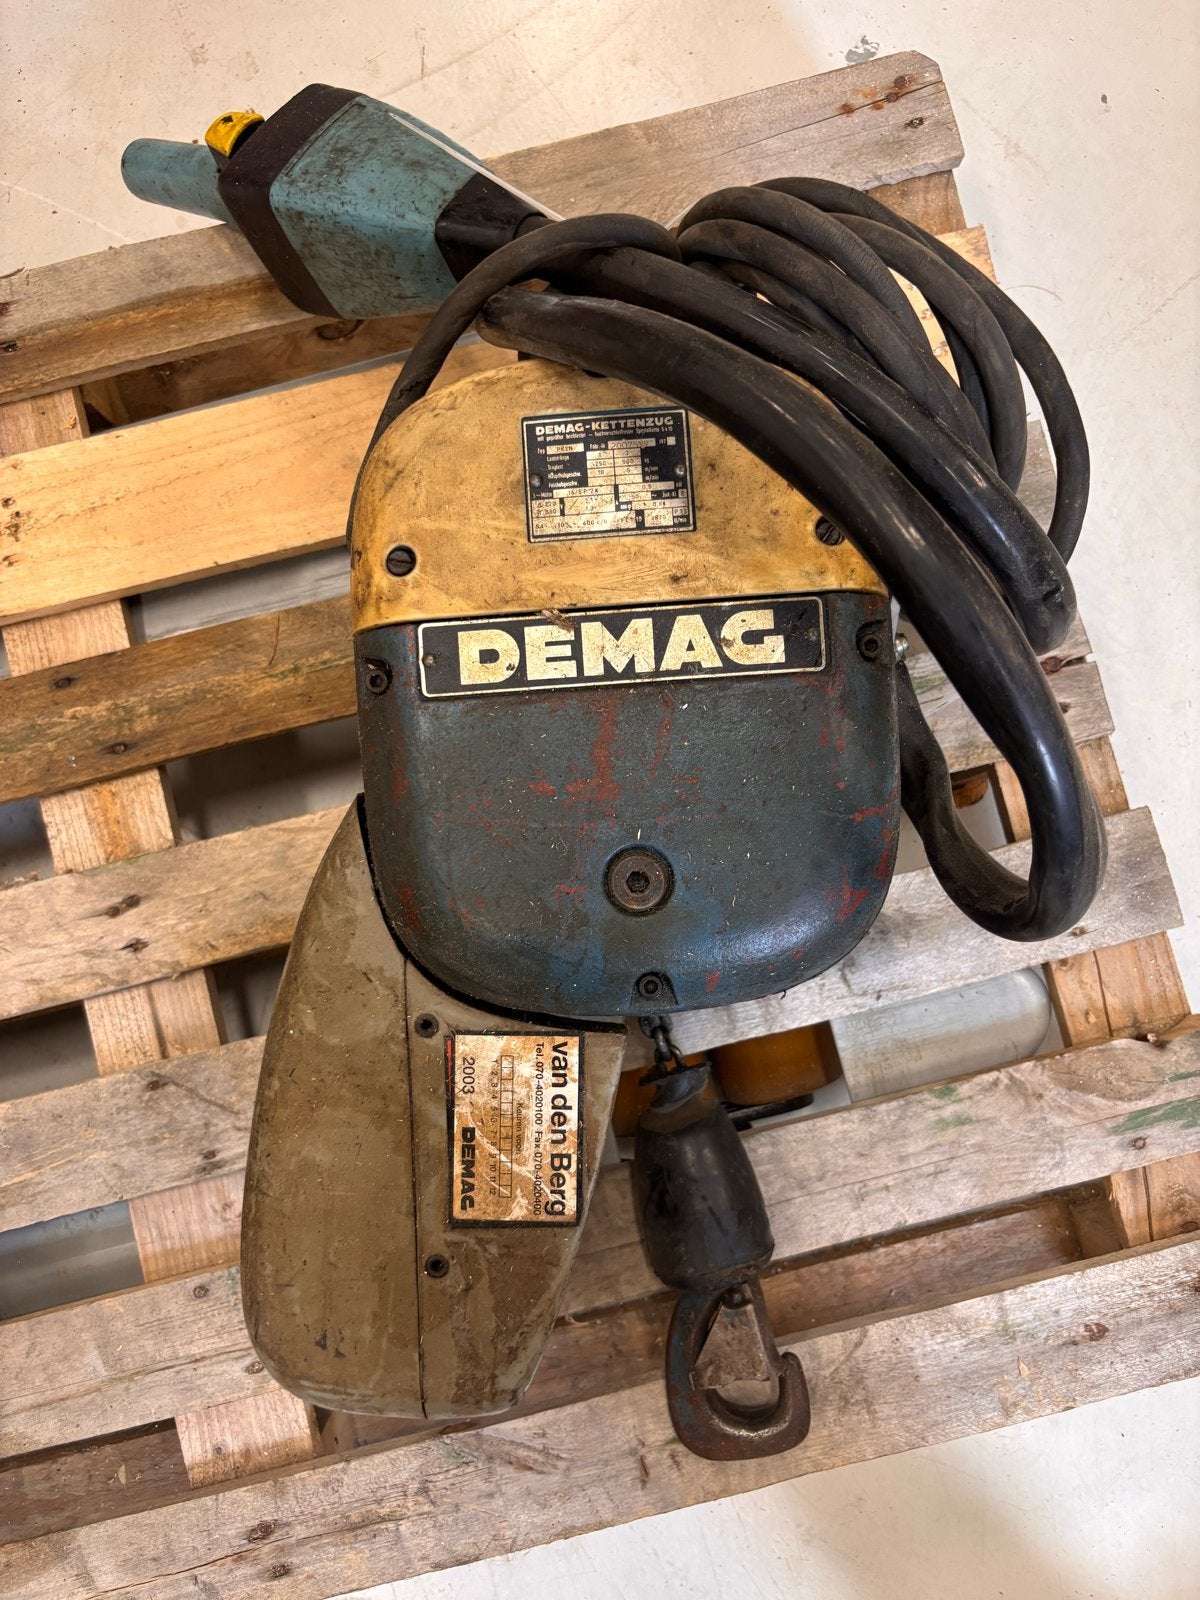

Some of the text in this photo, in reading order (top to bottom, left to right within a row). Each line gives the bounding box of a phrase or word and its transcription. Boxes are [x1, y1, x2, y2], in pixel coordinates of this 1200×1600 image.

[535, 416, 674, 436] DEMAG-KETTENZUG
[457, 609, 785, 686] DEMAG
[460, 1057, 476, 1211] 2003 DEMAG
[515, 1103, 524, 1131] Keuren
[533, 1042, 545, 1216] Tel. 070-4020100 Fax 070-4020400
[544, 1041, 573, 1216] van den Berg
